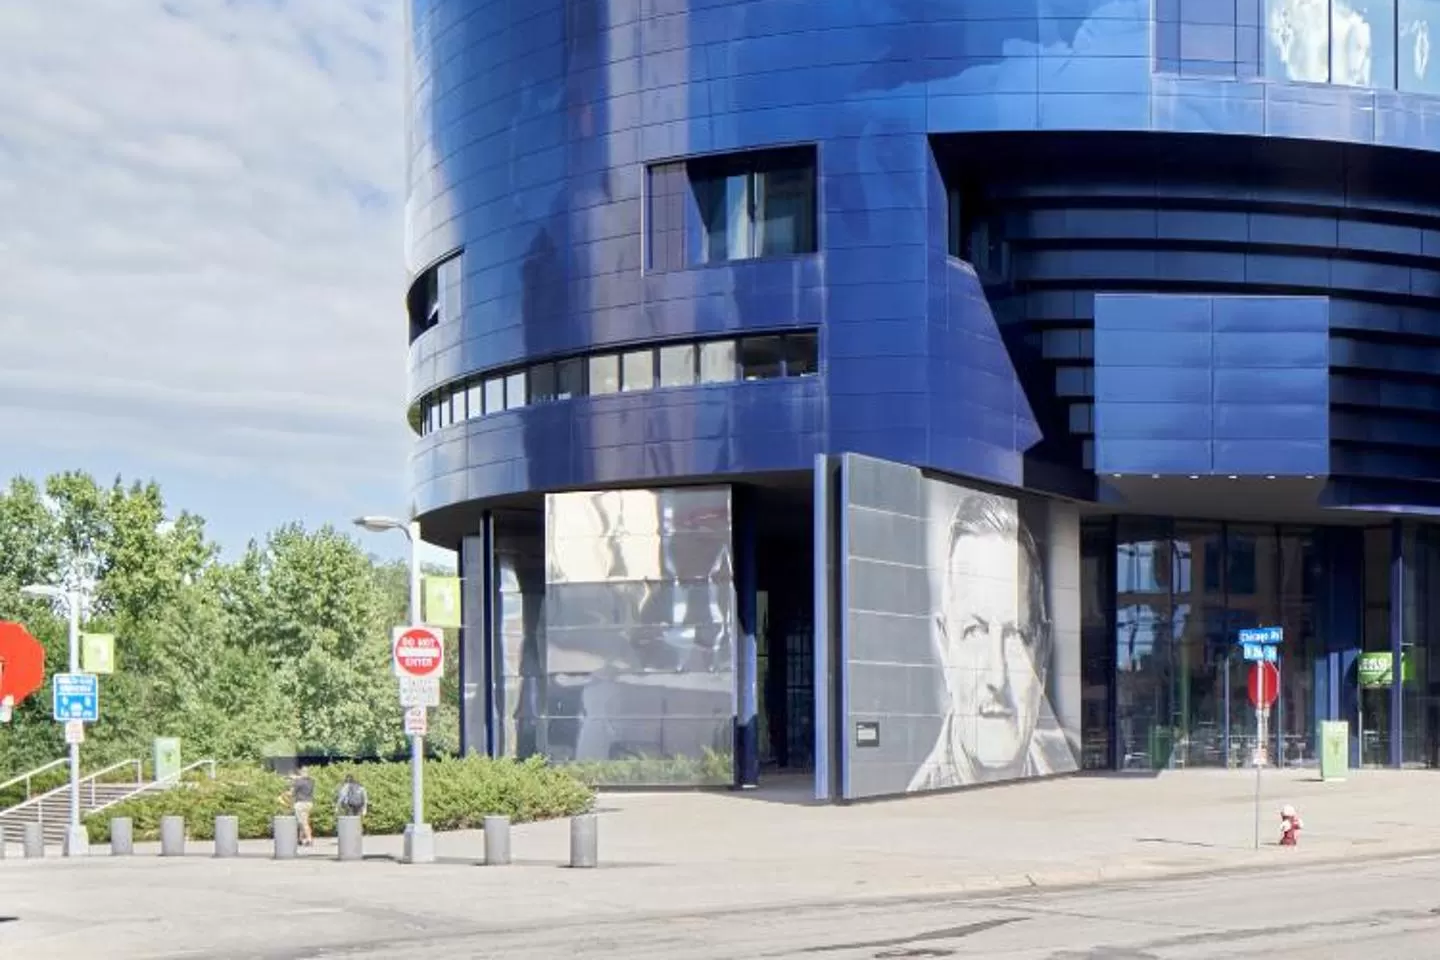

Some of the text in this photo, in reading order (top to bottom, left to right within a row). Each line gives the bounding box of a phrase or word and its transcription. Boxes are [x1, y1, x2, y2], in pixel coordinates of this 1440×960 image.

[402, 637, 435, 647] DO NOT
[405, 658, 433, 668] ENTER
